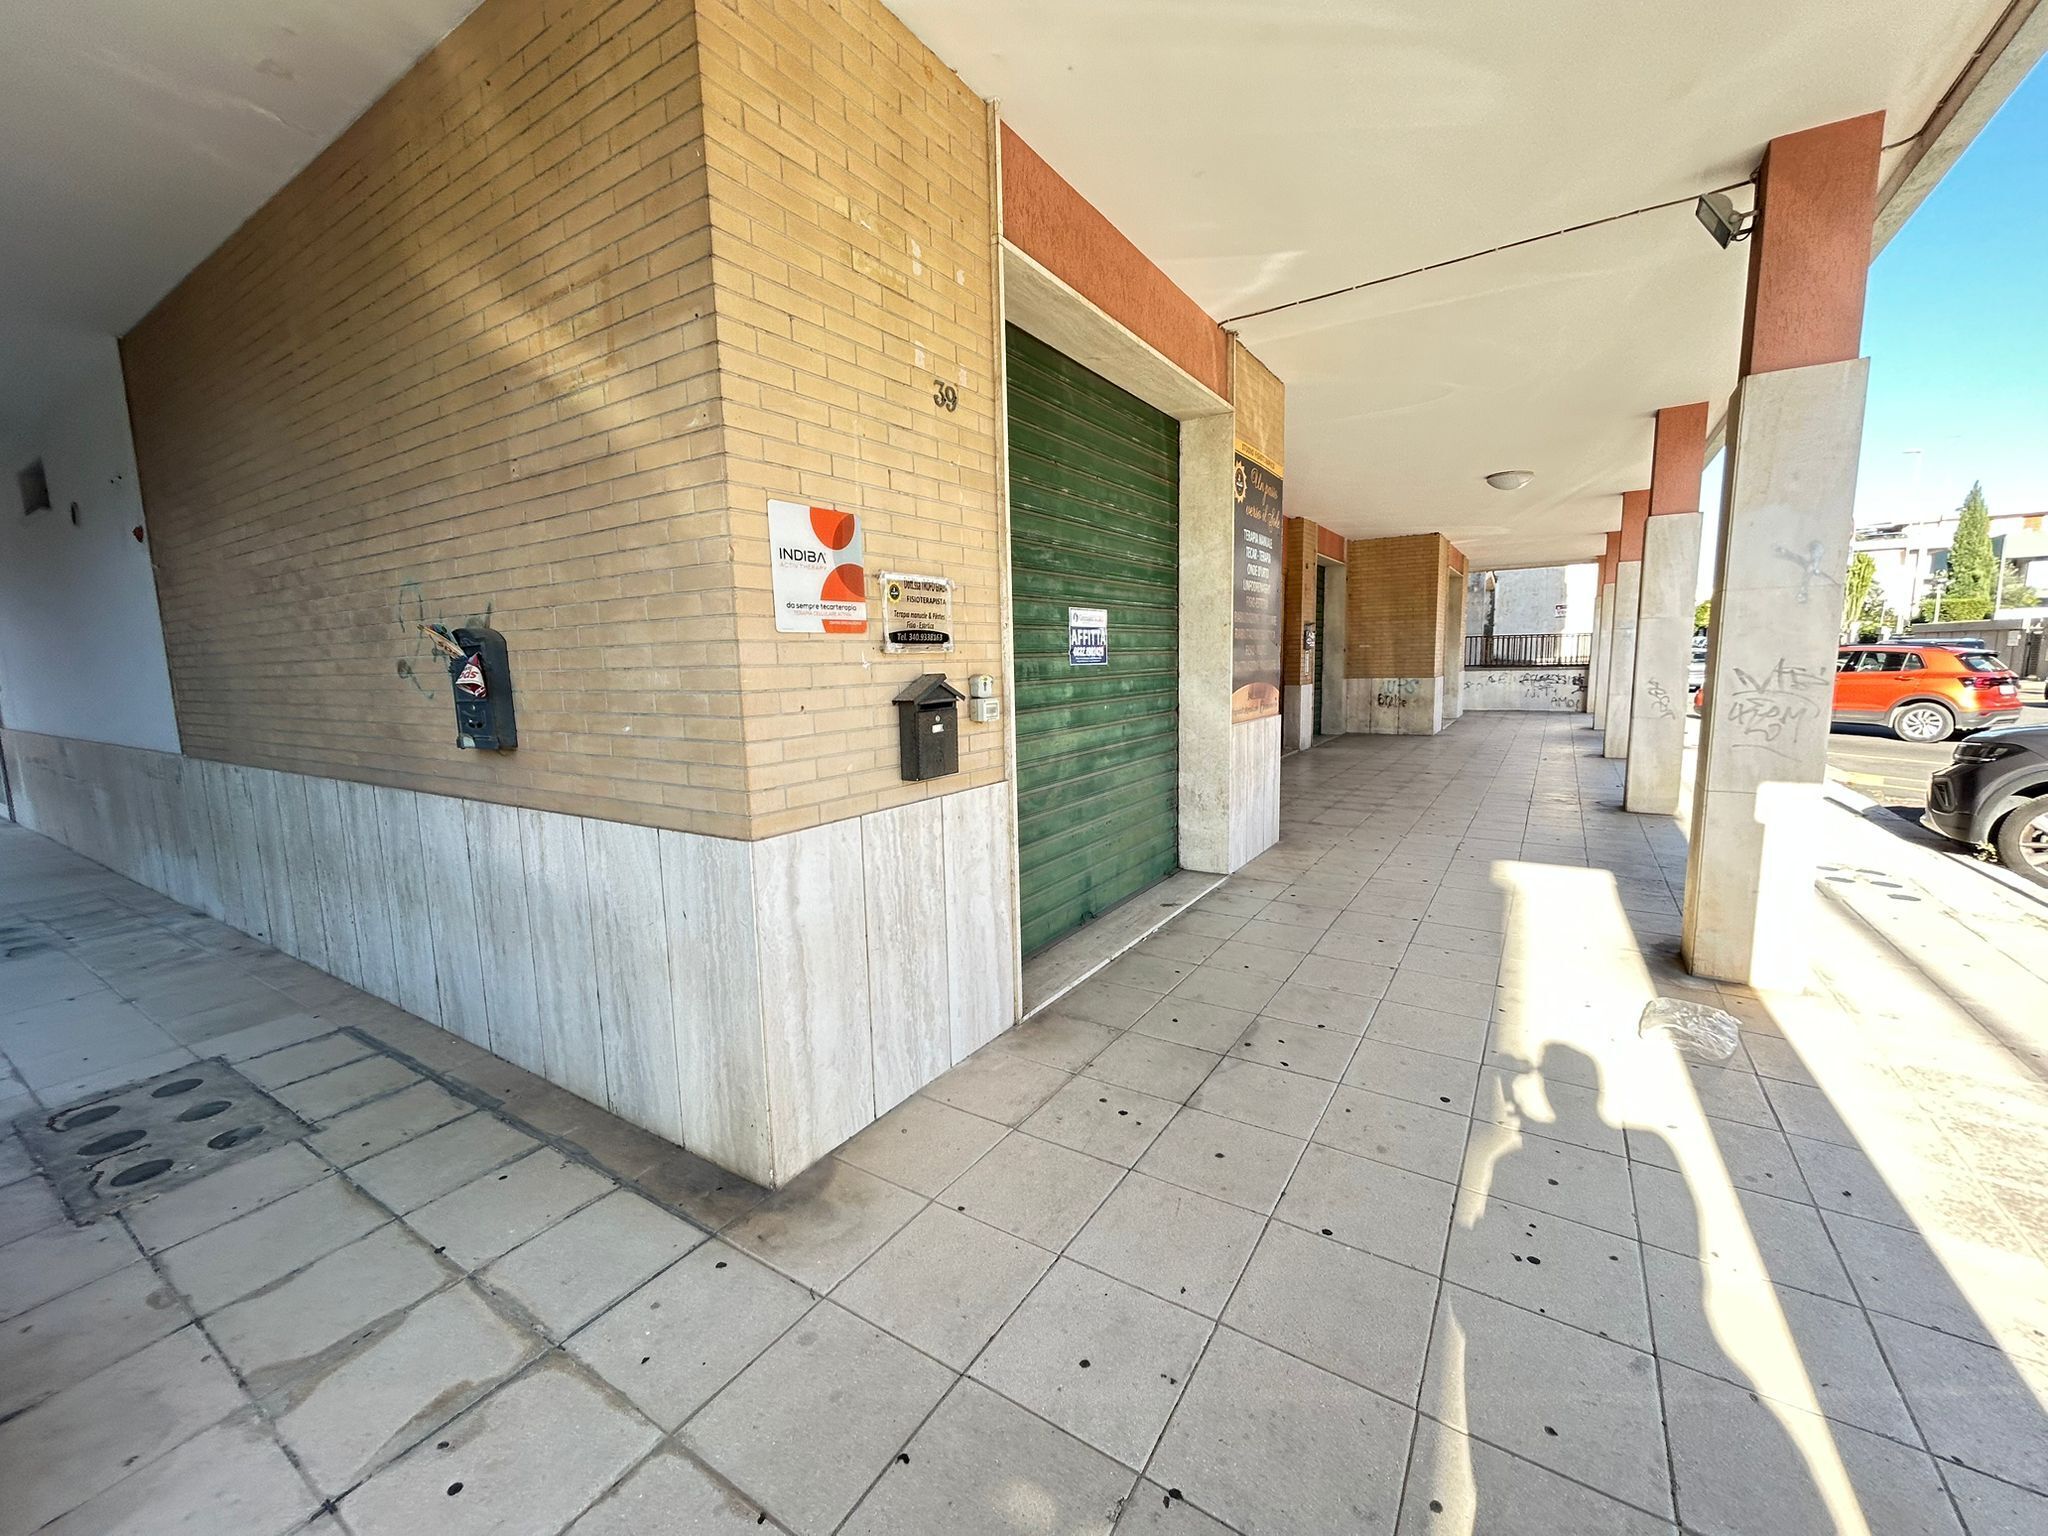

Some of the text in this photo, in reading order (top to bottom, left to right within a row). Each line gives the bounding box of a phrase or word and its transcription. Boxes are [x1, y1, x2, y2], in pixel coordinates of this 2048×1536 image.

[933, 379, 957, 413] 39
[1243, 528, 1258, 545] TERAPIA
[778, 547, 827, 564] INDIBA
[1246, 563, 1258, 577] ONDE
[786, 601, 857, 611] da sempre tecarterapia
[906, 595, 946, 605] FISIOTERAPISTA
[893, 609, 910, 619] Terapia
